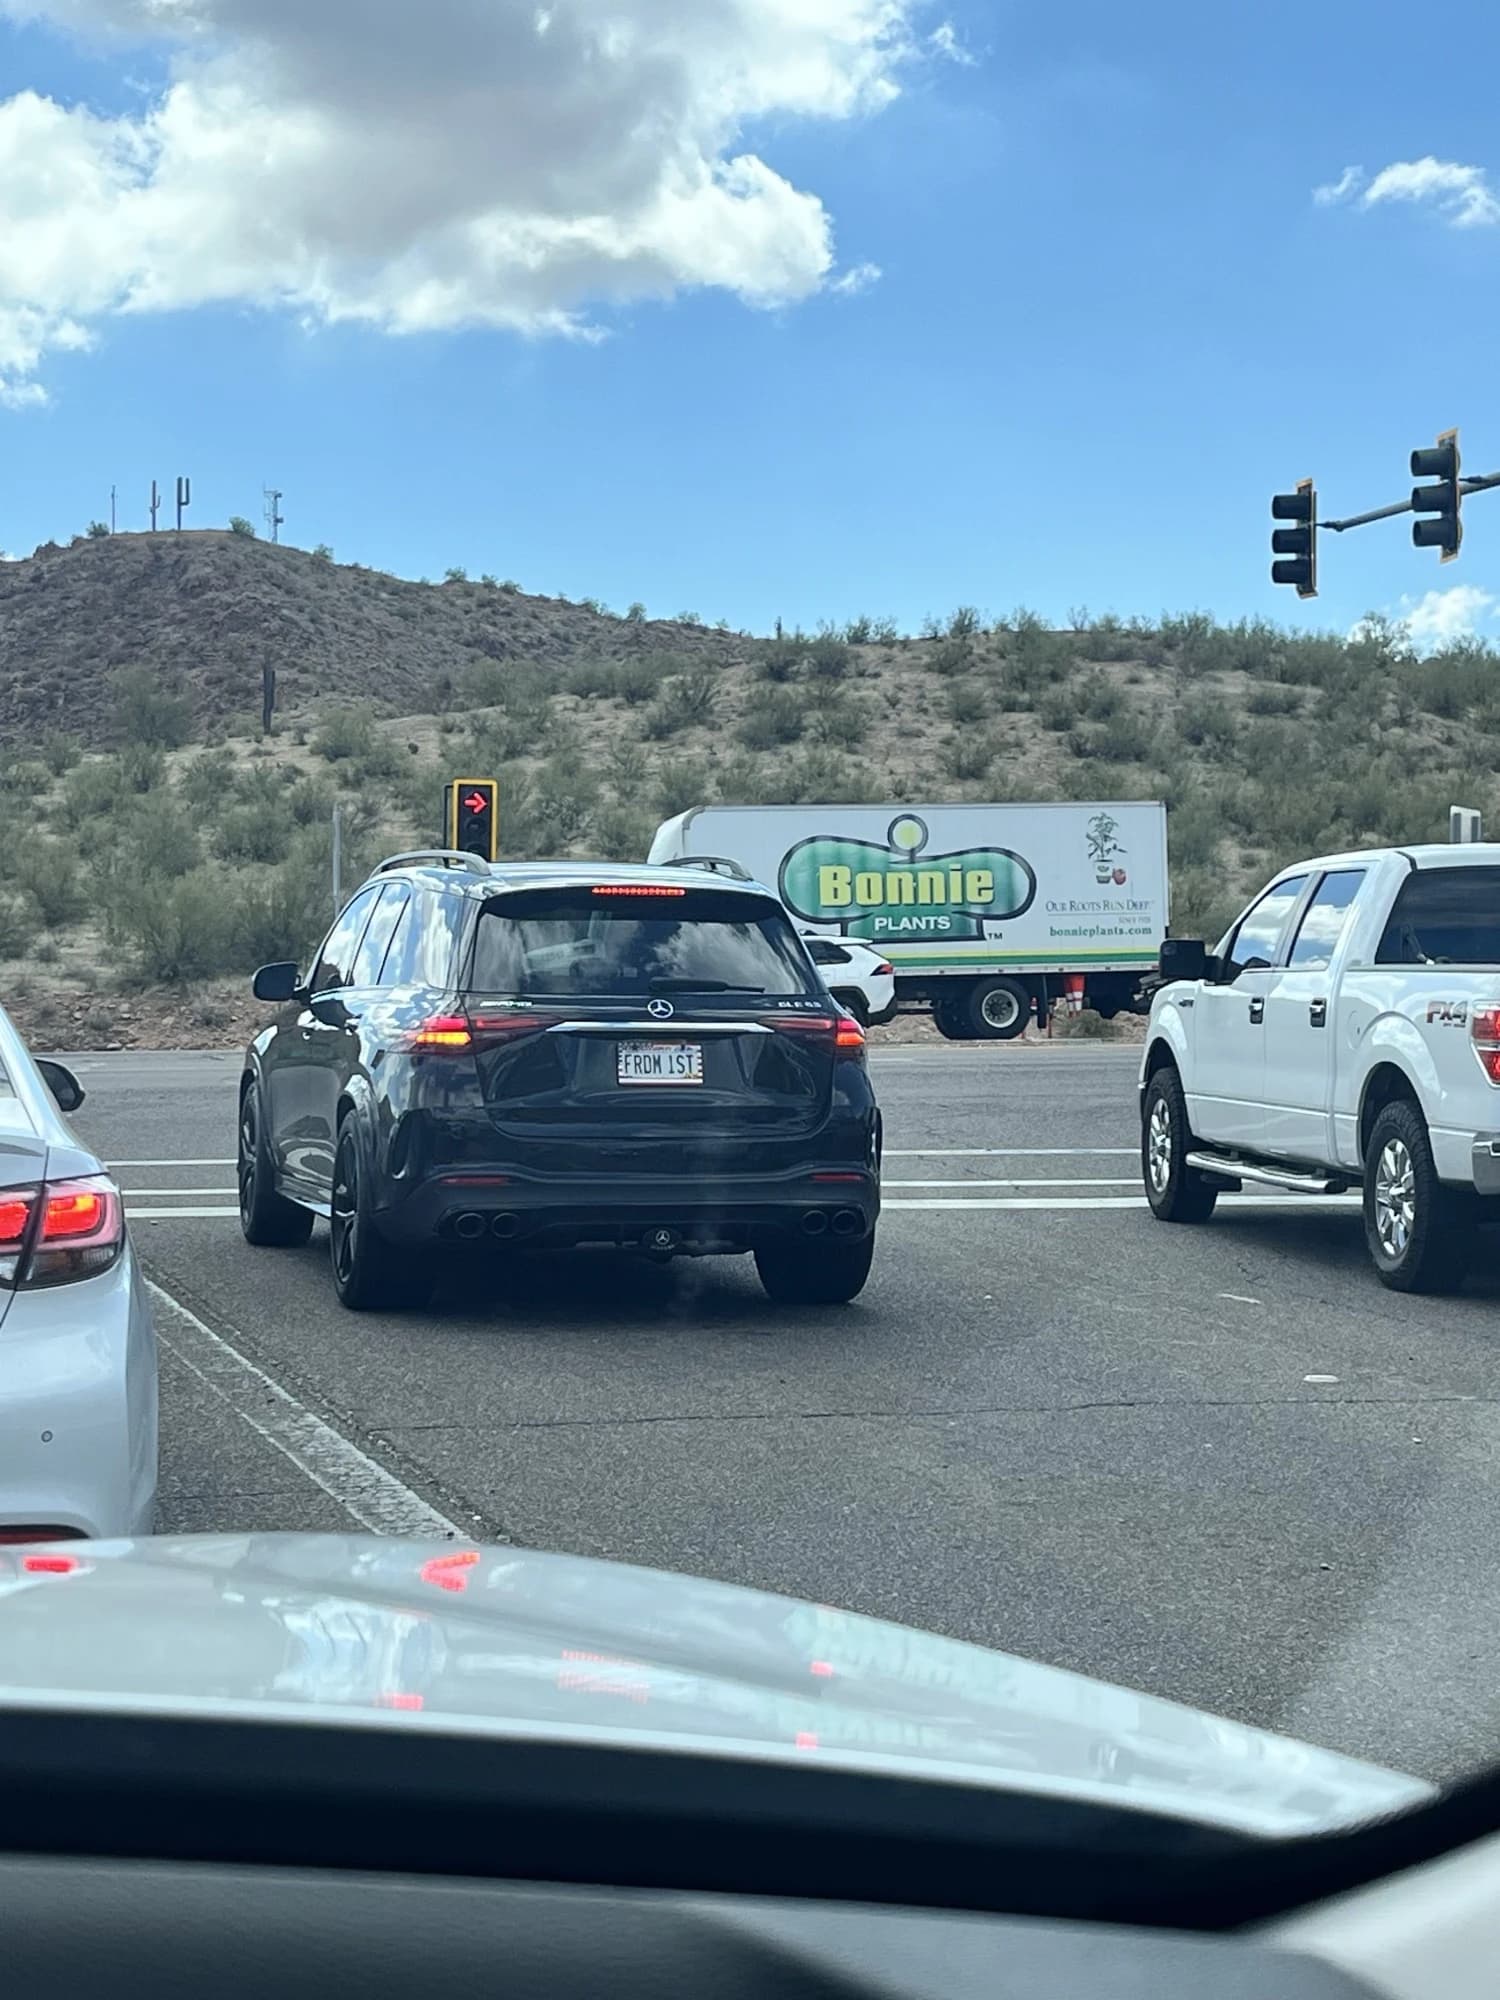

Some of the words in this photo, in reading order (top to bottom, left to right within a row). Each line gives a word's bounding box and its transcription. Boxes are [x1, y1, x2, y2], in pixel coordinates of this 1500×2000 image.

[819, 864, 995, 907] Bonnie
[1045, 900, 1067, 912] OUR
[1069, 900, 1101, 912] ROOTS
[874, 916, 951, 931] PLANTS
[1049, 925, 1152, 938] bonnieplants.com
[1426, 1000, 1468, 1024] FX4
[624, 1054, 662, 1074] FRDM
[668, 1054, 694, 1074] 1ST
